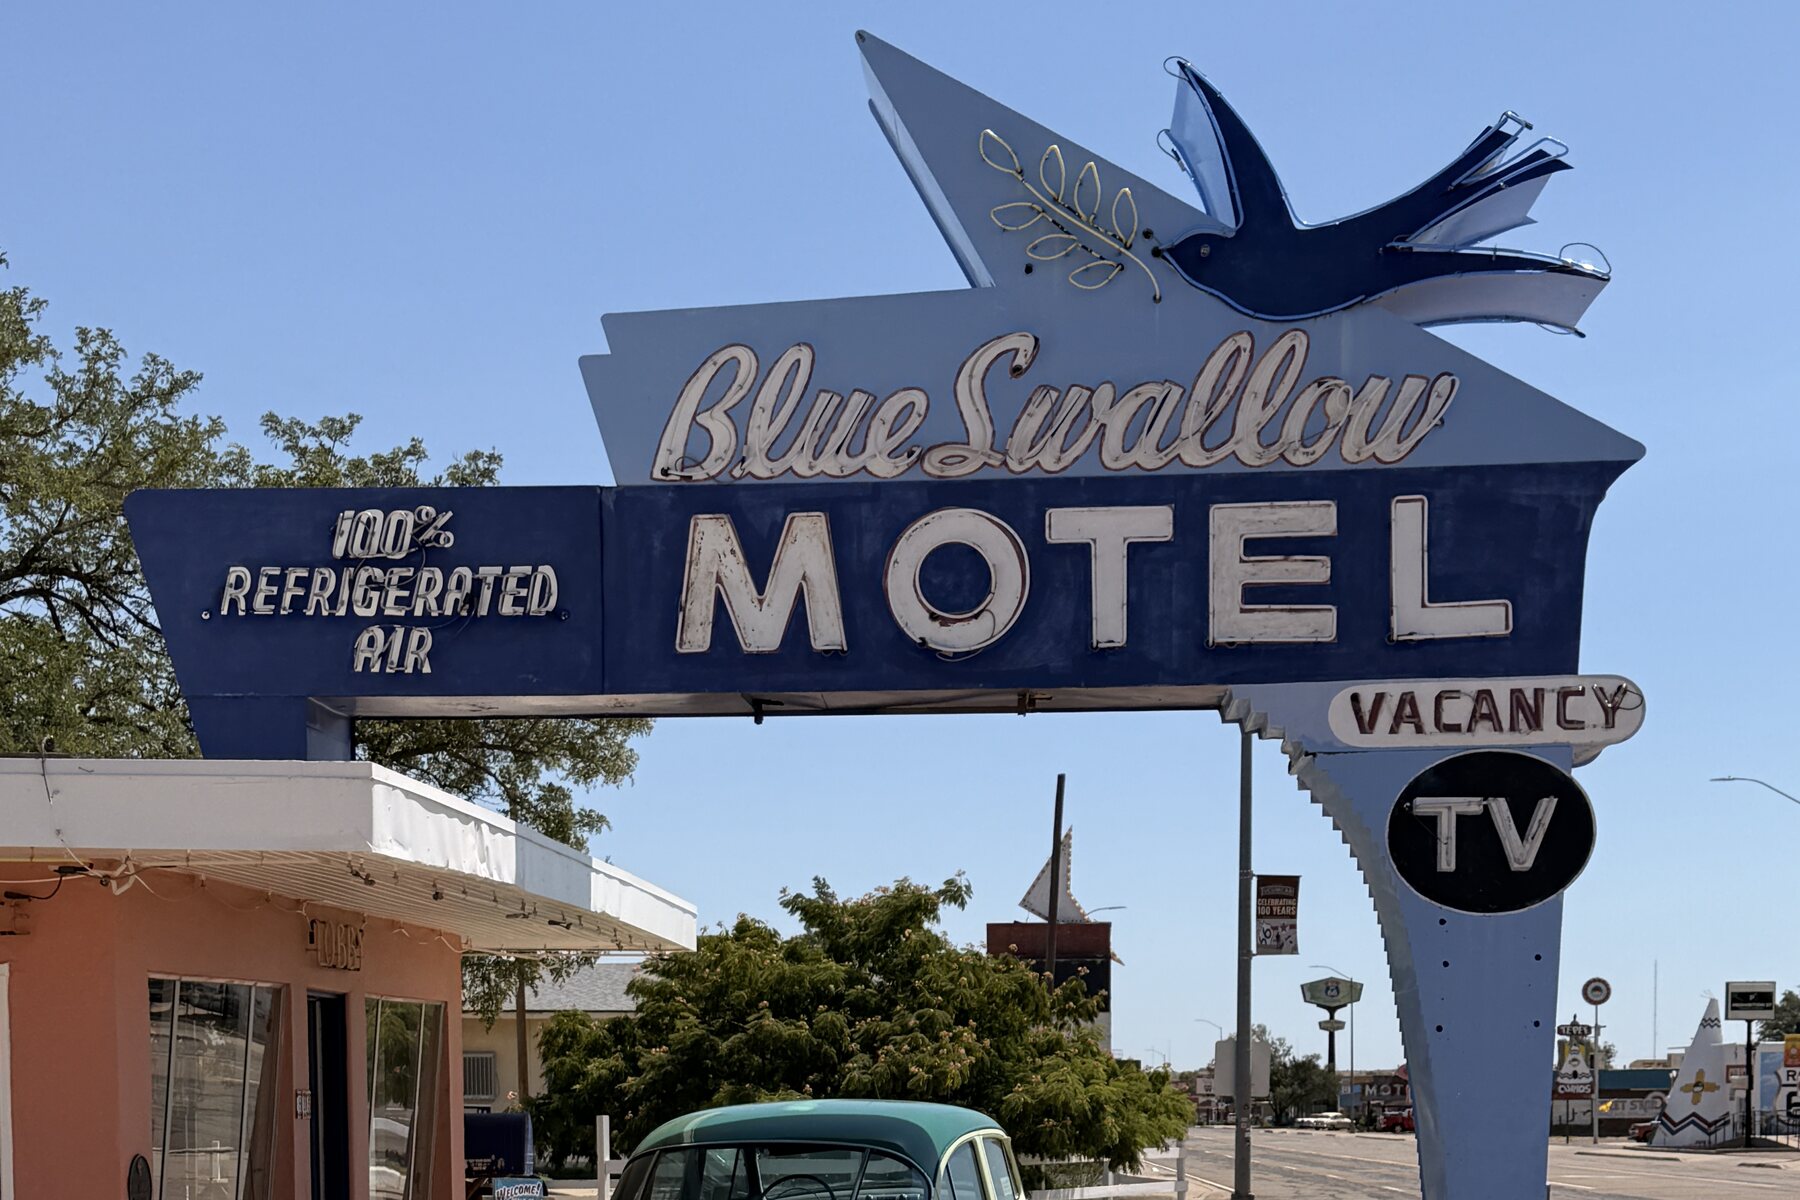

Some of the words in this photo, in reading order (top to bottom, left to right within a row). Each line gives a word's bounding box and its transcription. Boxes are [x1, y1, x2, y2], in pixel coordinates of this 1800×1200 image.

[651, 341, 929, 482] Blue
[922, 328, 1458, 478] Swallow
[331, 504, 455, 560] 100%
[220, 564, 560, 617] REFRIGERATED
[675, 494, 1514, 657] MOTEL
[353, 623, 434, 674] AIR
[1350, 683, 1630, 735] VACANCY
[1412, 796, 1559, 873] TV
[1257, 898, 1297, 907] CELEBRATING
[1257, 906, 1271, 916] 100
[1272, 906, 1297, 916] YEARS
[1364, 1083, 1404, 1097] MOT
[1786, 1069, 1800, 1082] R
